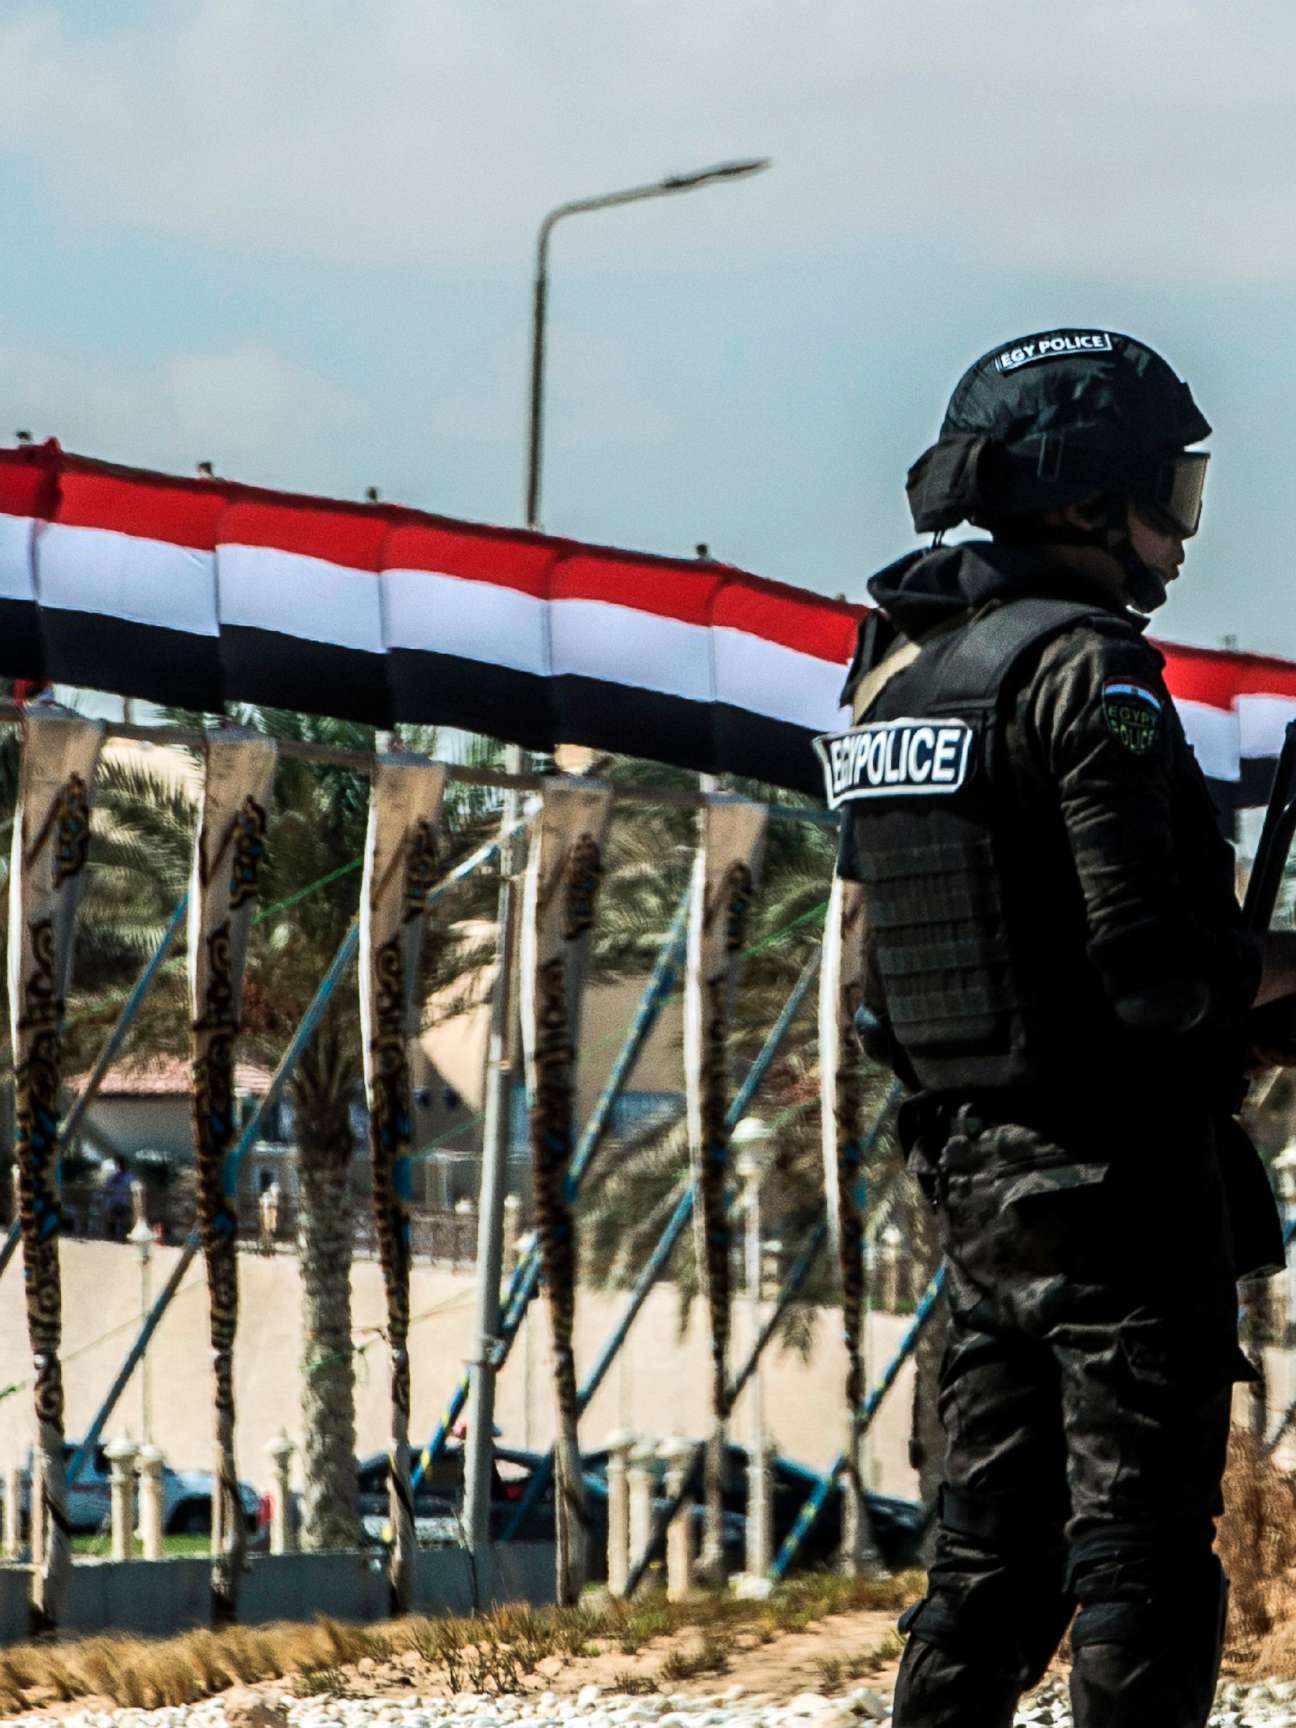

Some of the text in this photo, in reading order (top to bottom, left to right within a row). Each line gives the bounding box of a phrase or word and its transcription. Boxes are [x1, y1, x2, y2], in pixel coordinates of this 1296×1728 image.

[1000, 335, 1104, 367] EGY POLICE
[854, 727, 961, 785] POLICE
